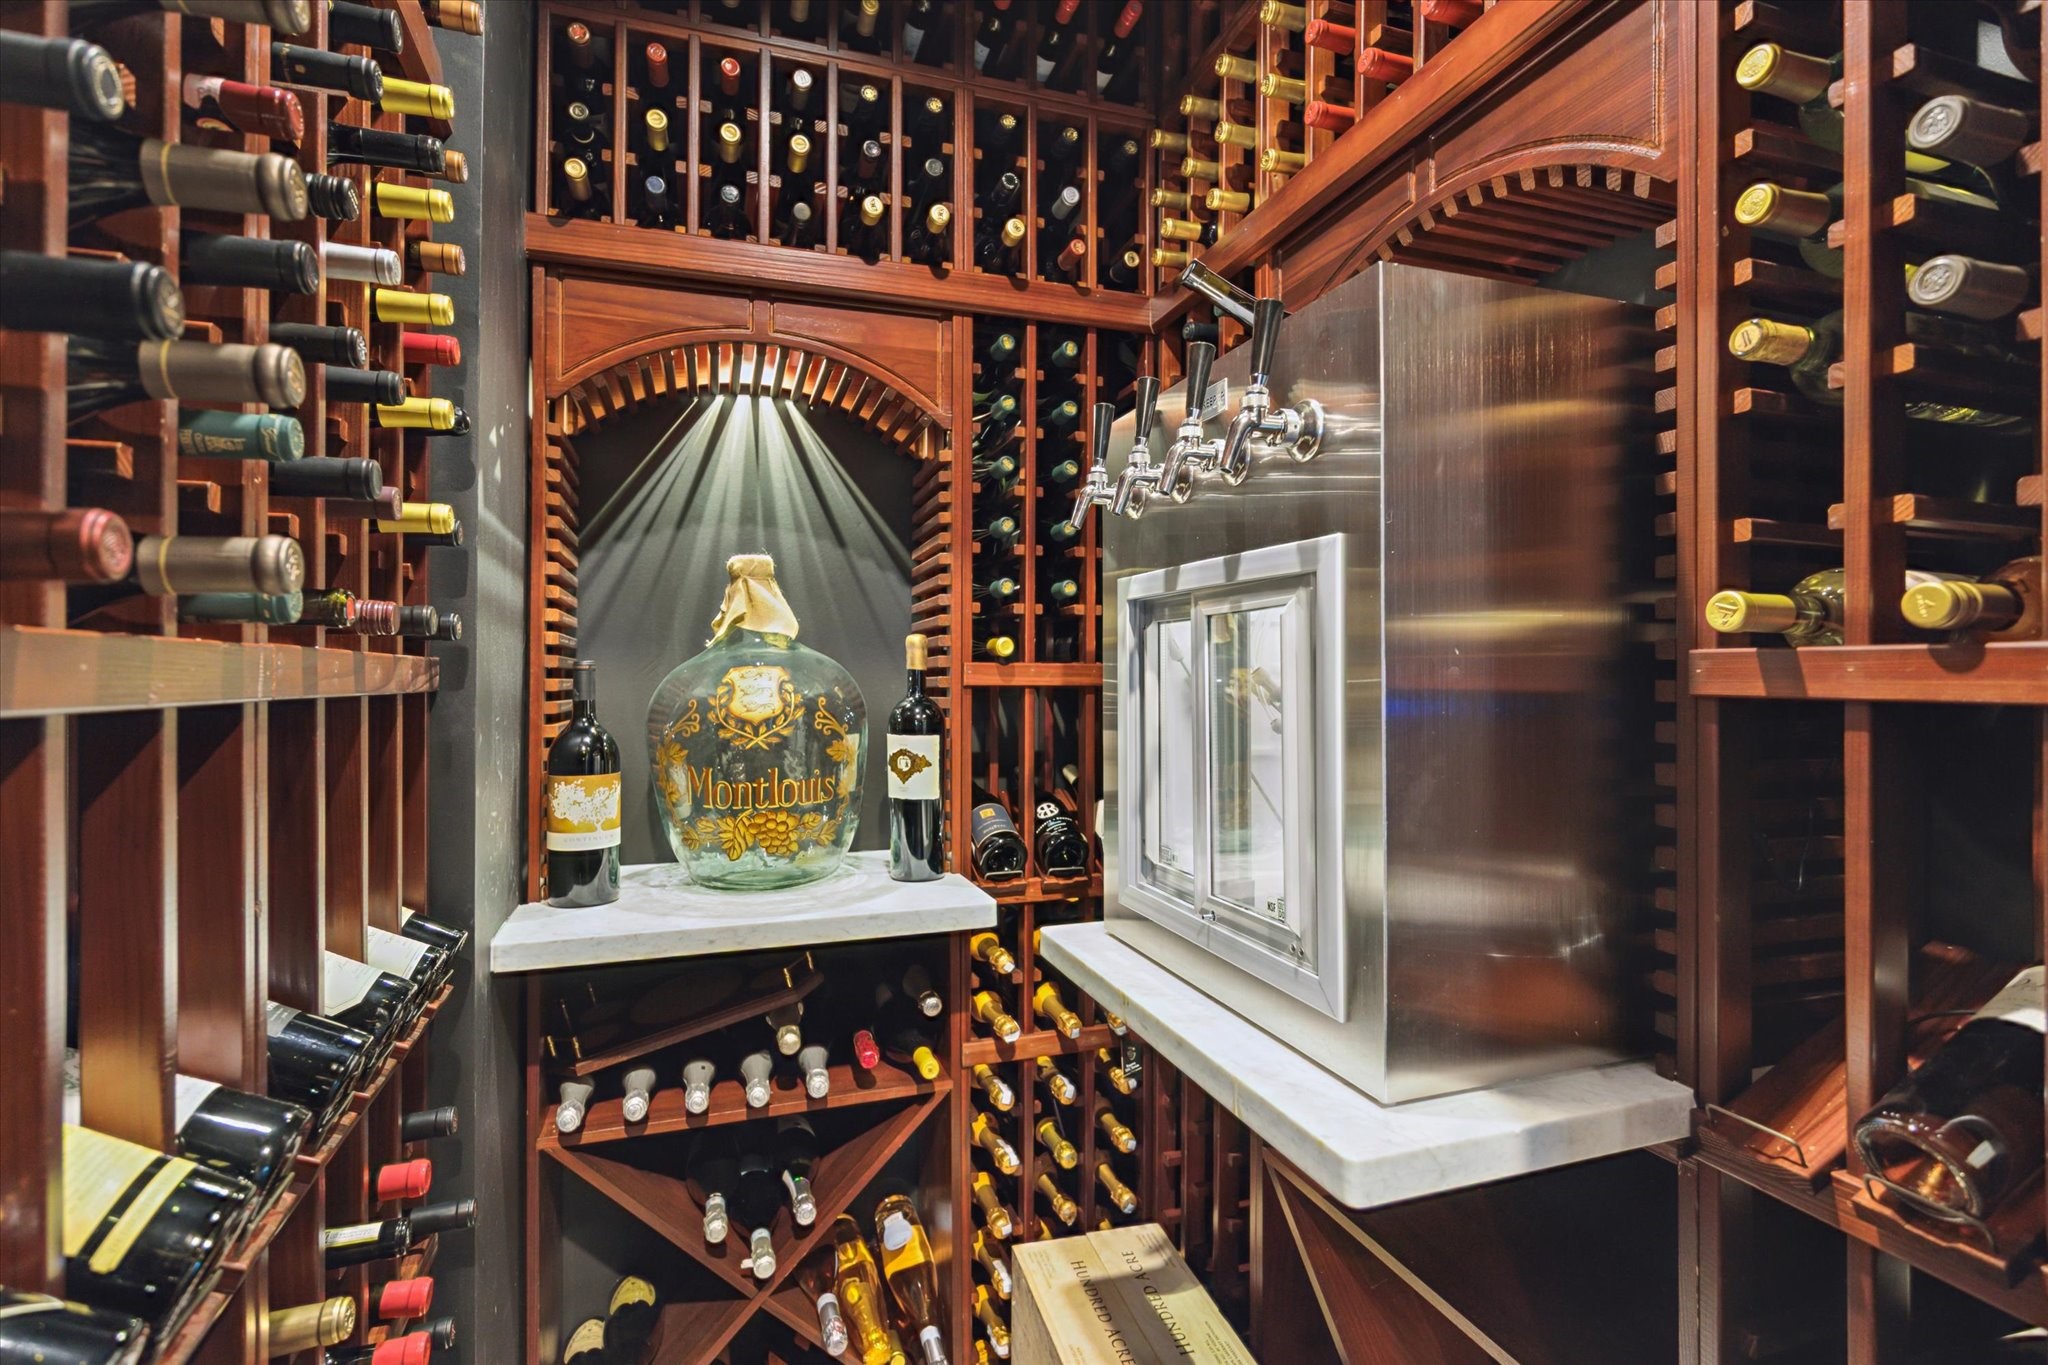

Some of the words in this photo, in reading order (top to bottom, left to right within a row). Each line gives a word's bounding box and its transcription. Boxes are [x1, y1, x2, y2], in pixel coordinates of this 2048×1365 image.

[687, 765, 837, 809] Montlouis
[1121, 1251, 1151, 1282] ACRE
[1070, 1260, 1113, 1324] HUNDRED
[1105, 1328, 1137, 1365] ACRE
[1143, 1285, 1195, 1356] HUNDRED
